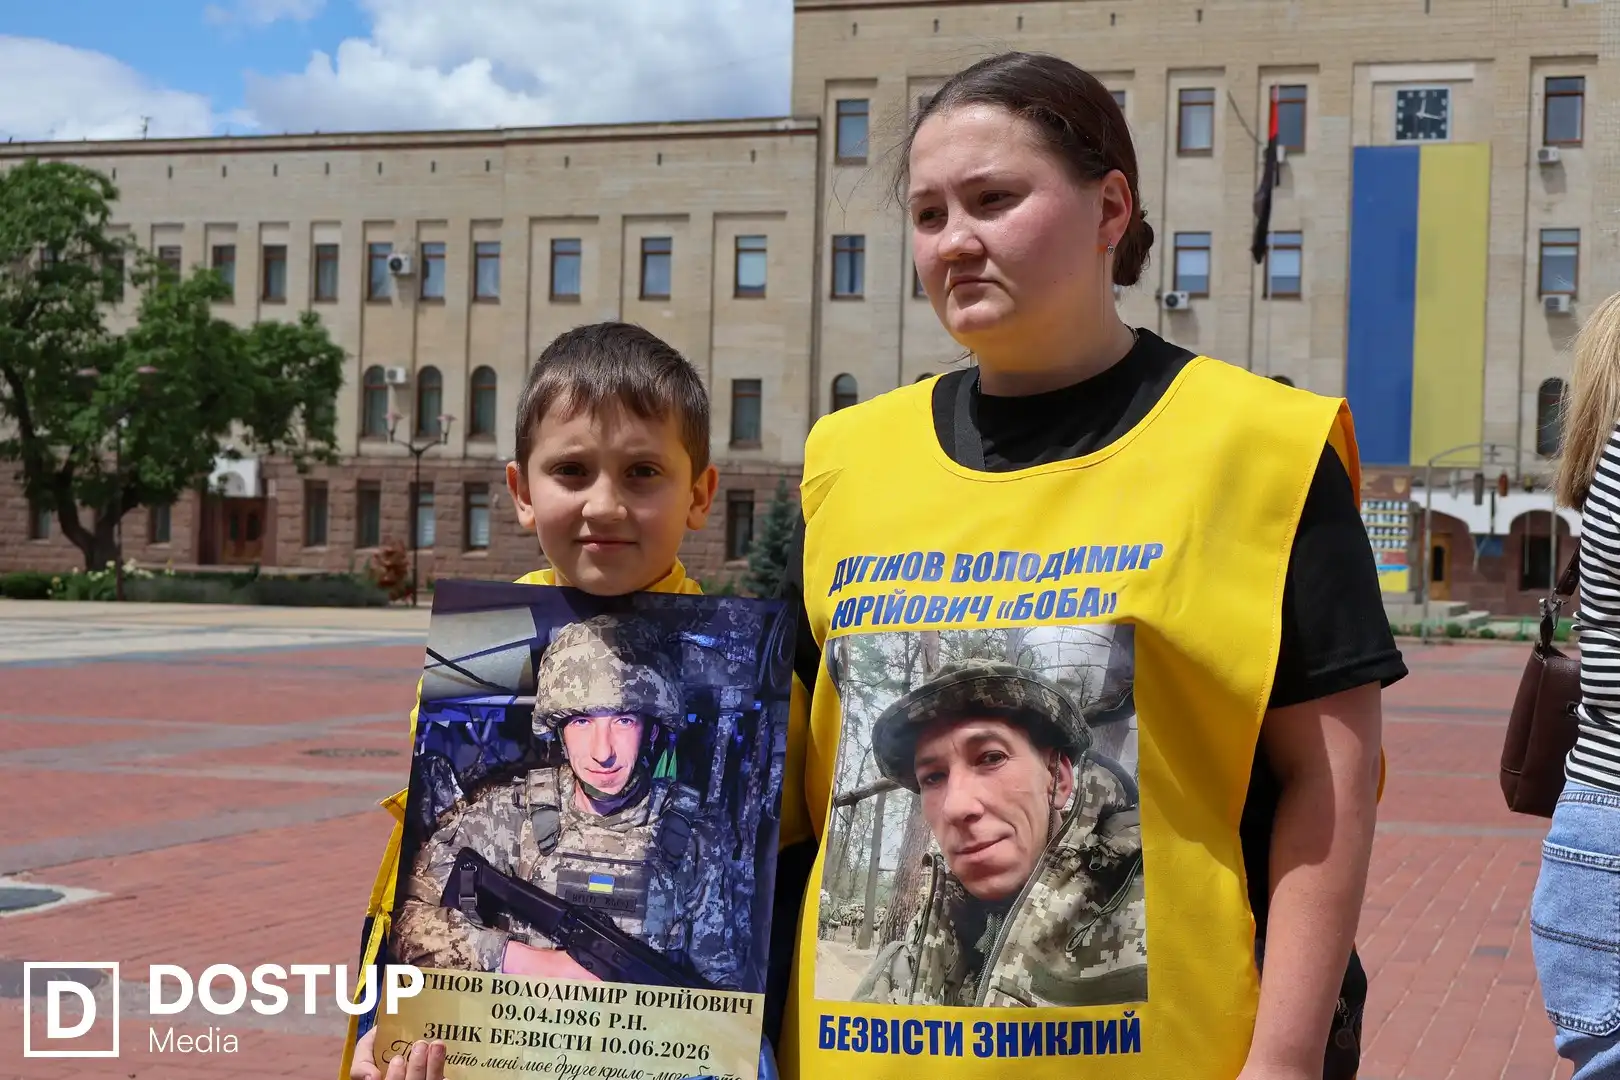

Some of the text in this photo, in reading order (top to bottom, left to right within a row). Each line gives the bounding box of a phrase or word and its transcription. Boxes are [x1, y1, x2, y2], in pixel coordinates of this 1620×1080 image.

[828, 542, 1164, 597] ДУГІНОВ ВОЛОДИМИР
[831, 587, 1117, 631] ЮРІЙОВИЧ «БОБА»
[388, 973, 754, 1015] ГІНОВ ВОЛОДИМИР ЮРІЙОВИЧ
[490, 1003, 648, 1031] 09.04.1986 Р.Н.
[818, 1010, 1141, 1058] БЕЗВІСТИ ЗНИКЛИЙ
[423, 1022, 711, 1061] ЗНИК БЕЗВІСТИ 10.06.2026
